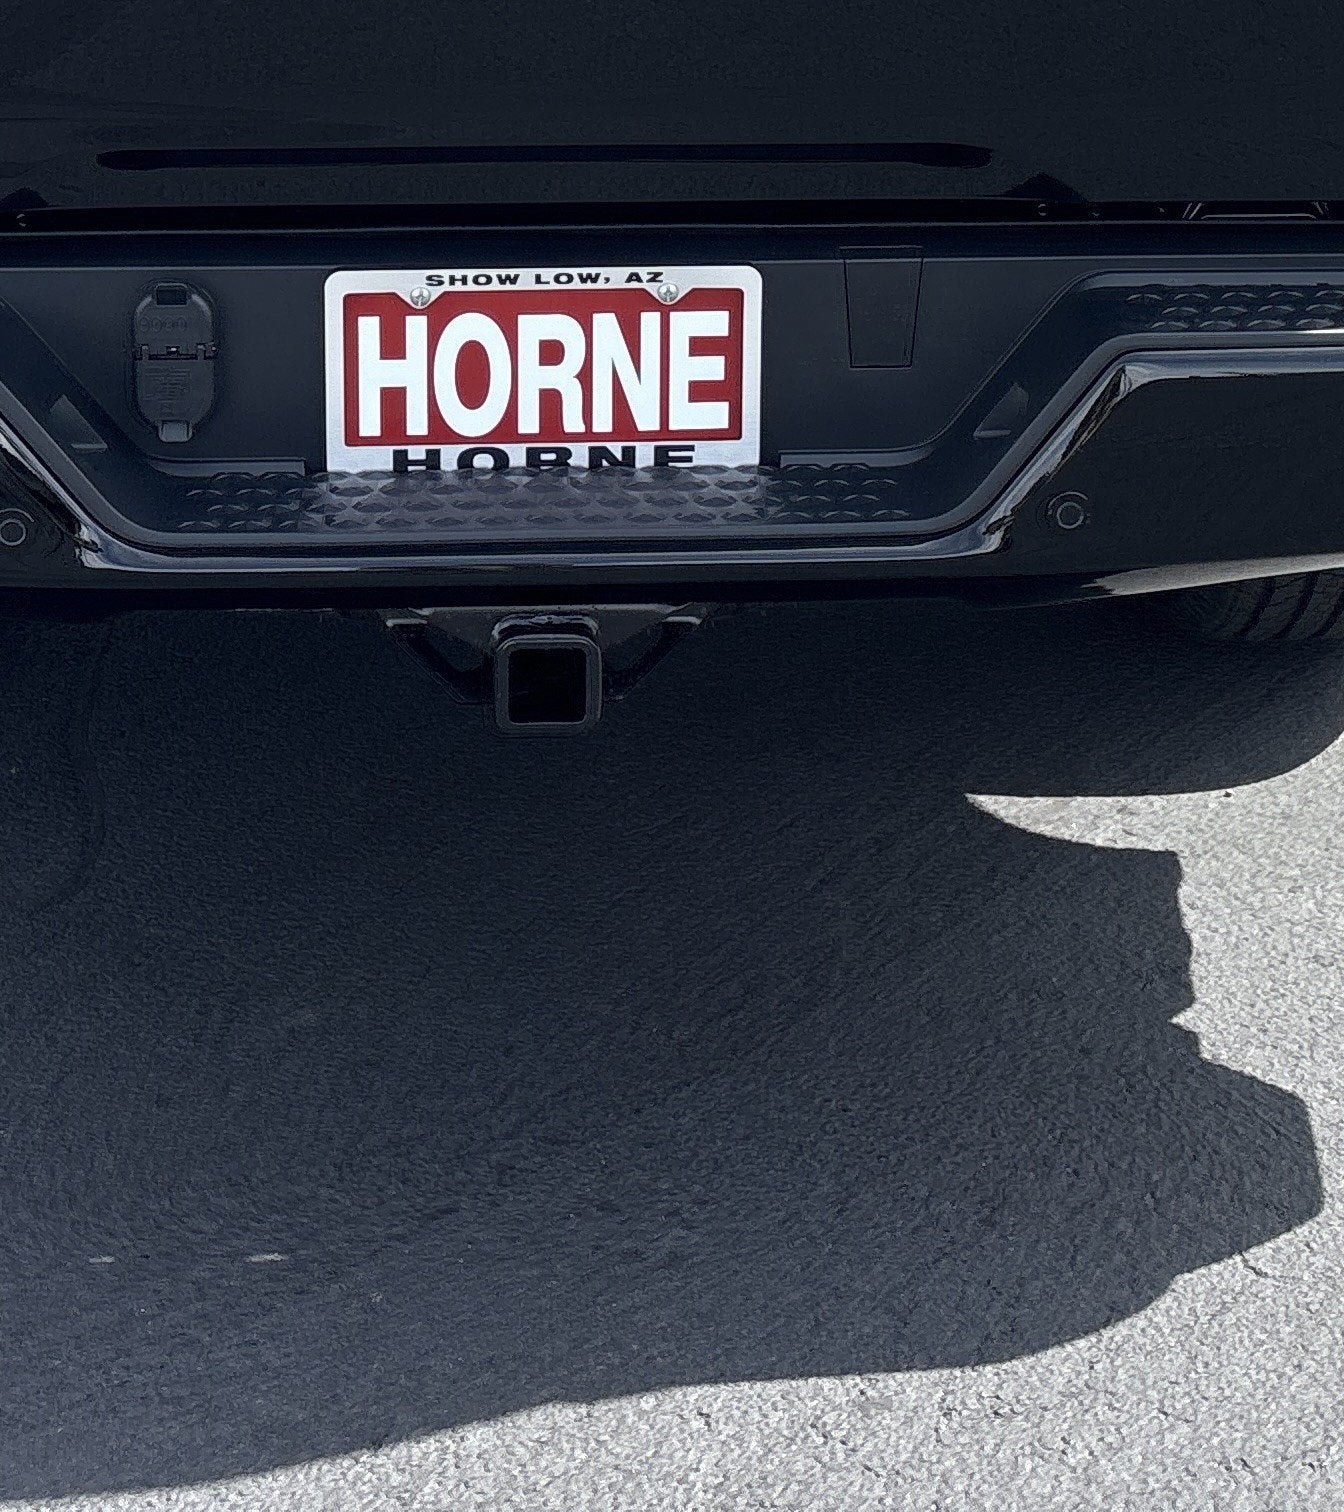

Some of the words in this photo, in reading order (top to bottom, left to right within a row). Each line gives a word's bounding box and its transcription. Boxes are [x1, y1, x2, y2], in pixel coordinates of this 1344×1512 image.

[425, 273, 520, 286] SHOW
[534, 271, 611, 285] LOW,
[624, 271, 664, 284] AZ
[356, 309, 730, 438] HORNE
